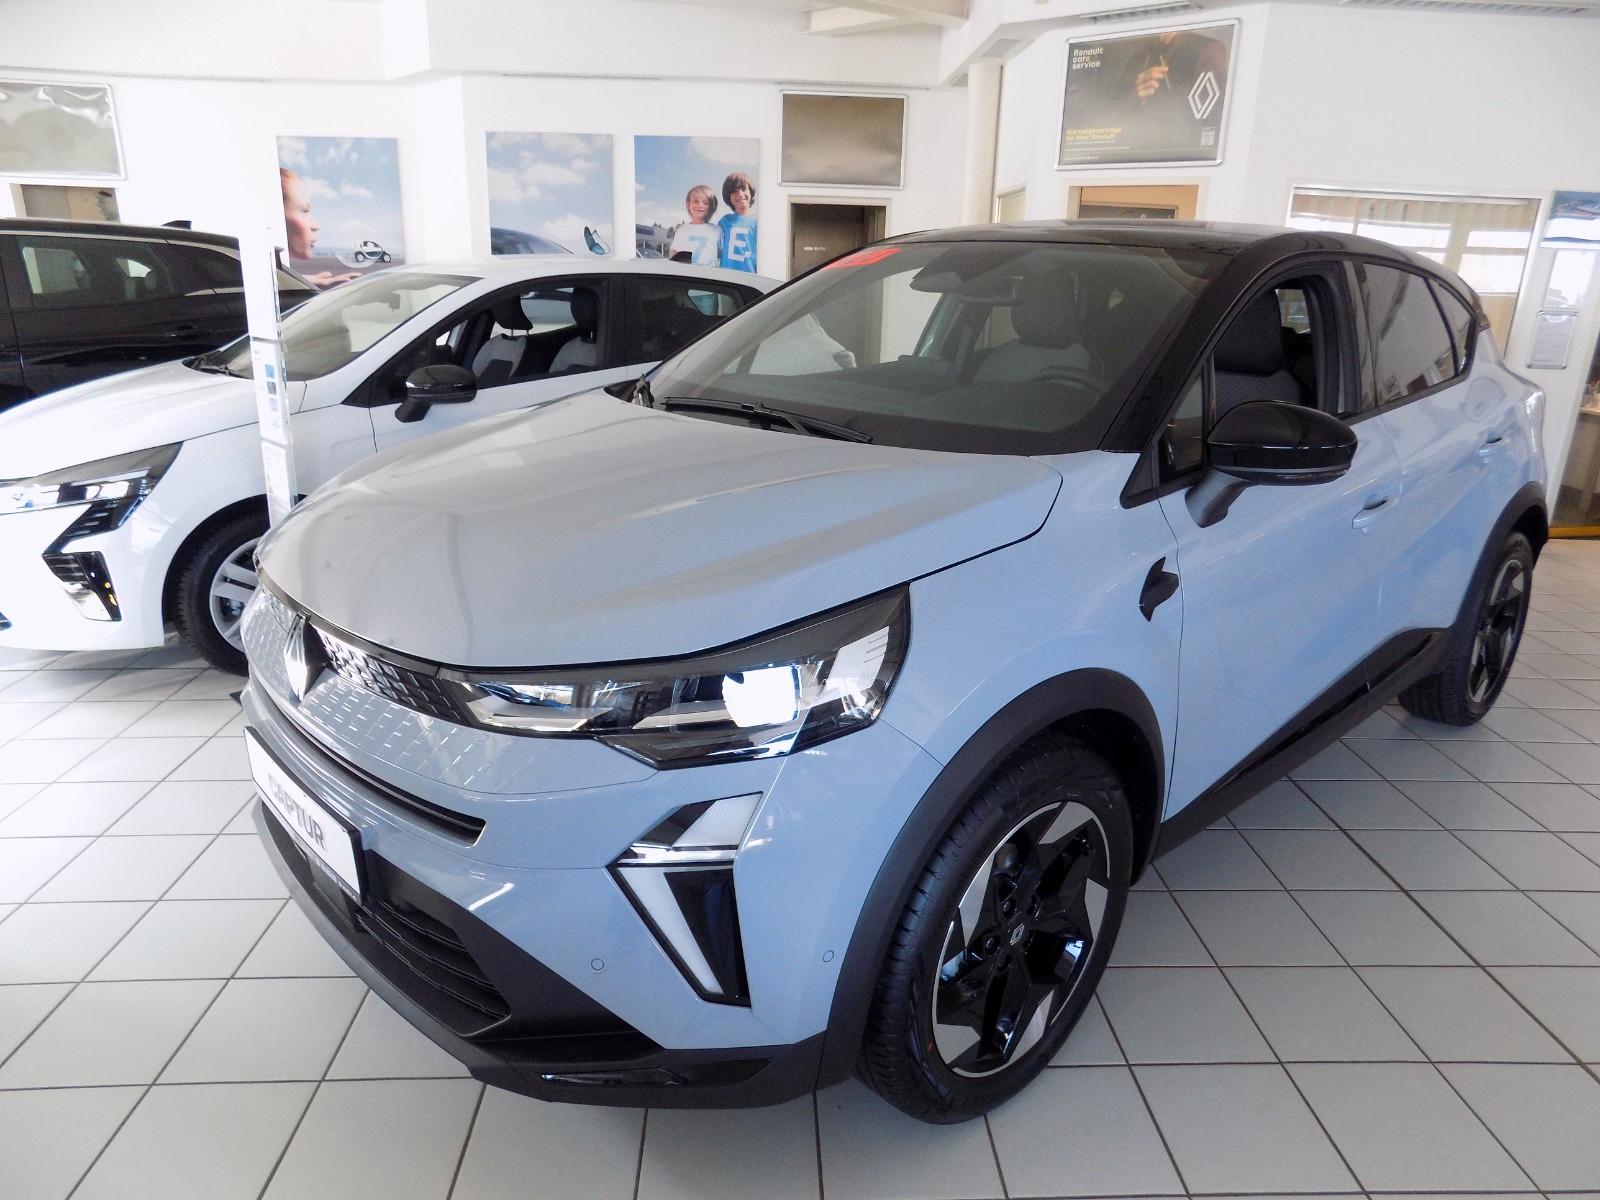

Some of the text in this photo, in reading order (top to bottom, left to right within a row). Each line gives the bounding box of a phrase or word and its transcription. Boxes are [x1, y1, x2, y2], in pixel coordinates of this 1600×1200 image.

[1073, 48, 1103, 56] Renault
[1072, 61, 1101, 69] service
[728, 227, 751, 262] E
